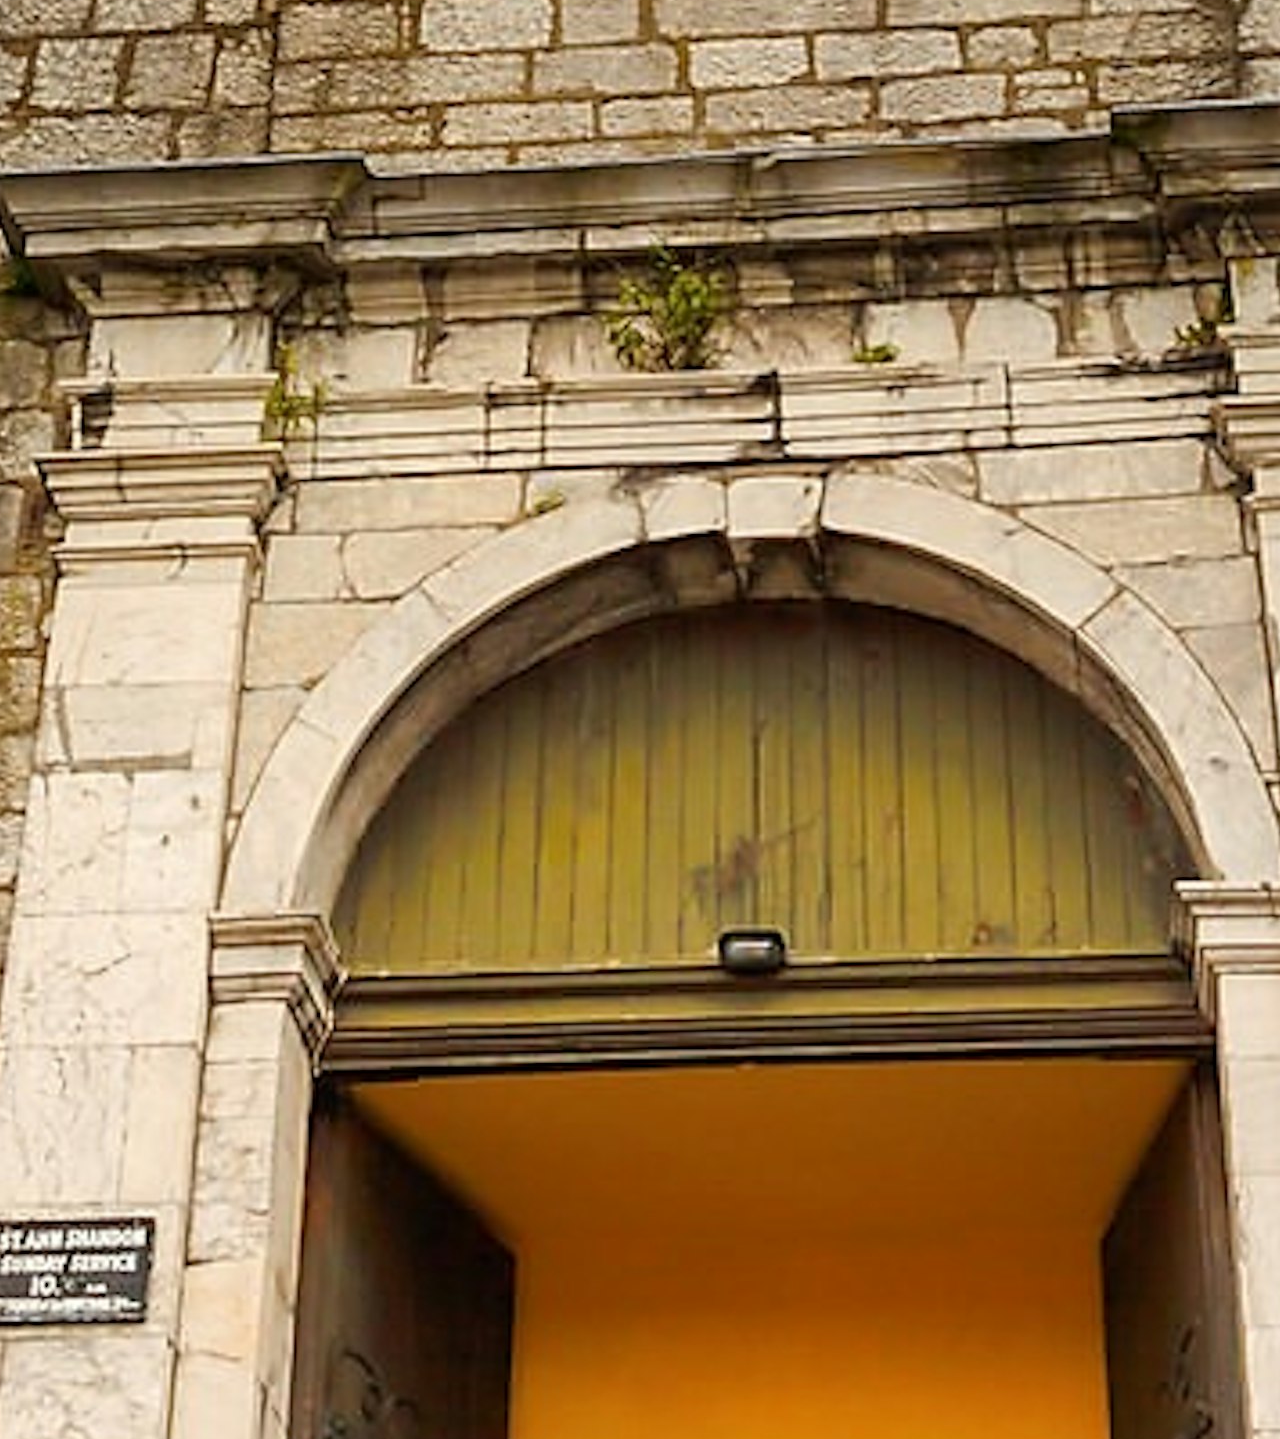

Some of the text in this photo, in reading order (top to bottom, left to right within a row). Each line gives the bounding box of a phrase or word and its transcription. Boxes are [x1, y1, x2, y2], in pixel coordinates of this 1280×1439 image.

[64, 1225, 148, 1248] SHANDON
[0, 1251, 137, 1275] SUNDAY SERVICE
